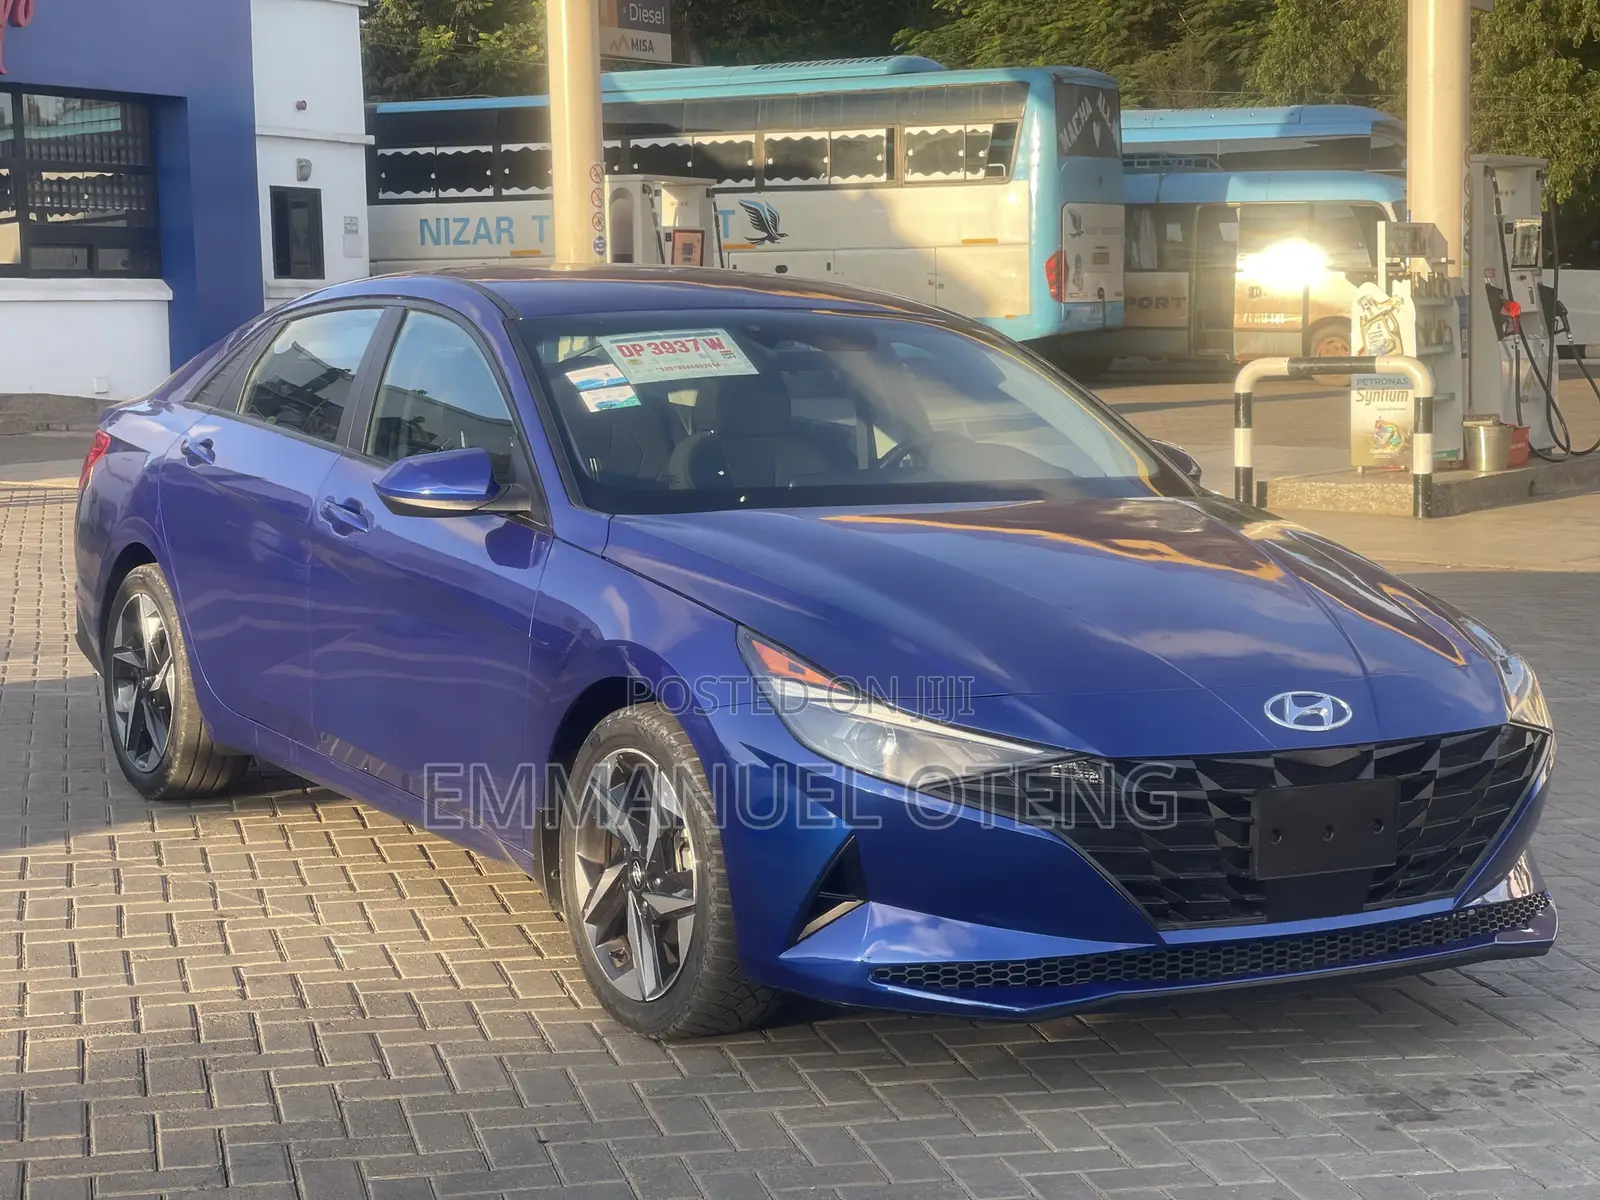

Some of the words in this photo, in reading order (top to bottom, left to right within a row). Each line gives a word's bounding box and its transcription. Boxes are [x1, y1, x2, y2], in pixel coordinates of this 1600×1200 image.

[629, 3, 665, 25] Diesel
[631, 37, 655, 53] MISA
[419, 215, 515, 247] NIZAR
[615, 343, 645, 358] DP
[647, 338, 700, 356] 3937
[702, 336, 726, 351] W
[1356, 377, 1409, 387] PETRONAS
[1356, 387, 1409, 406] Syntium
